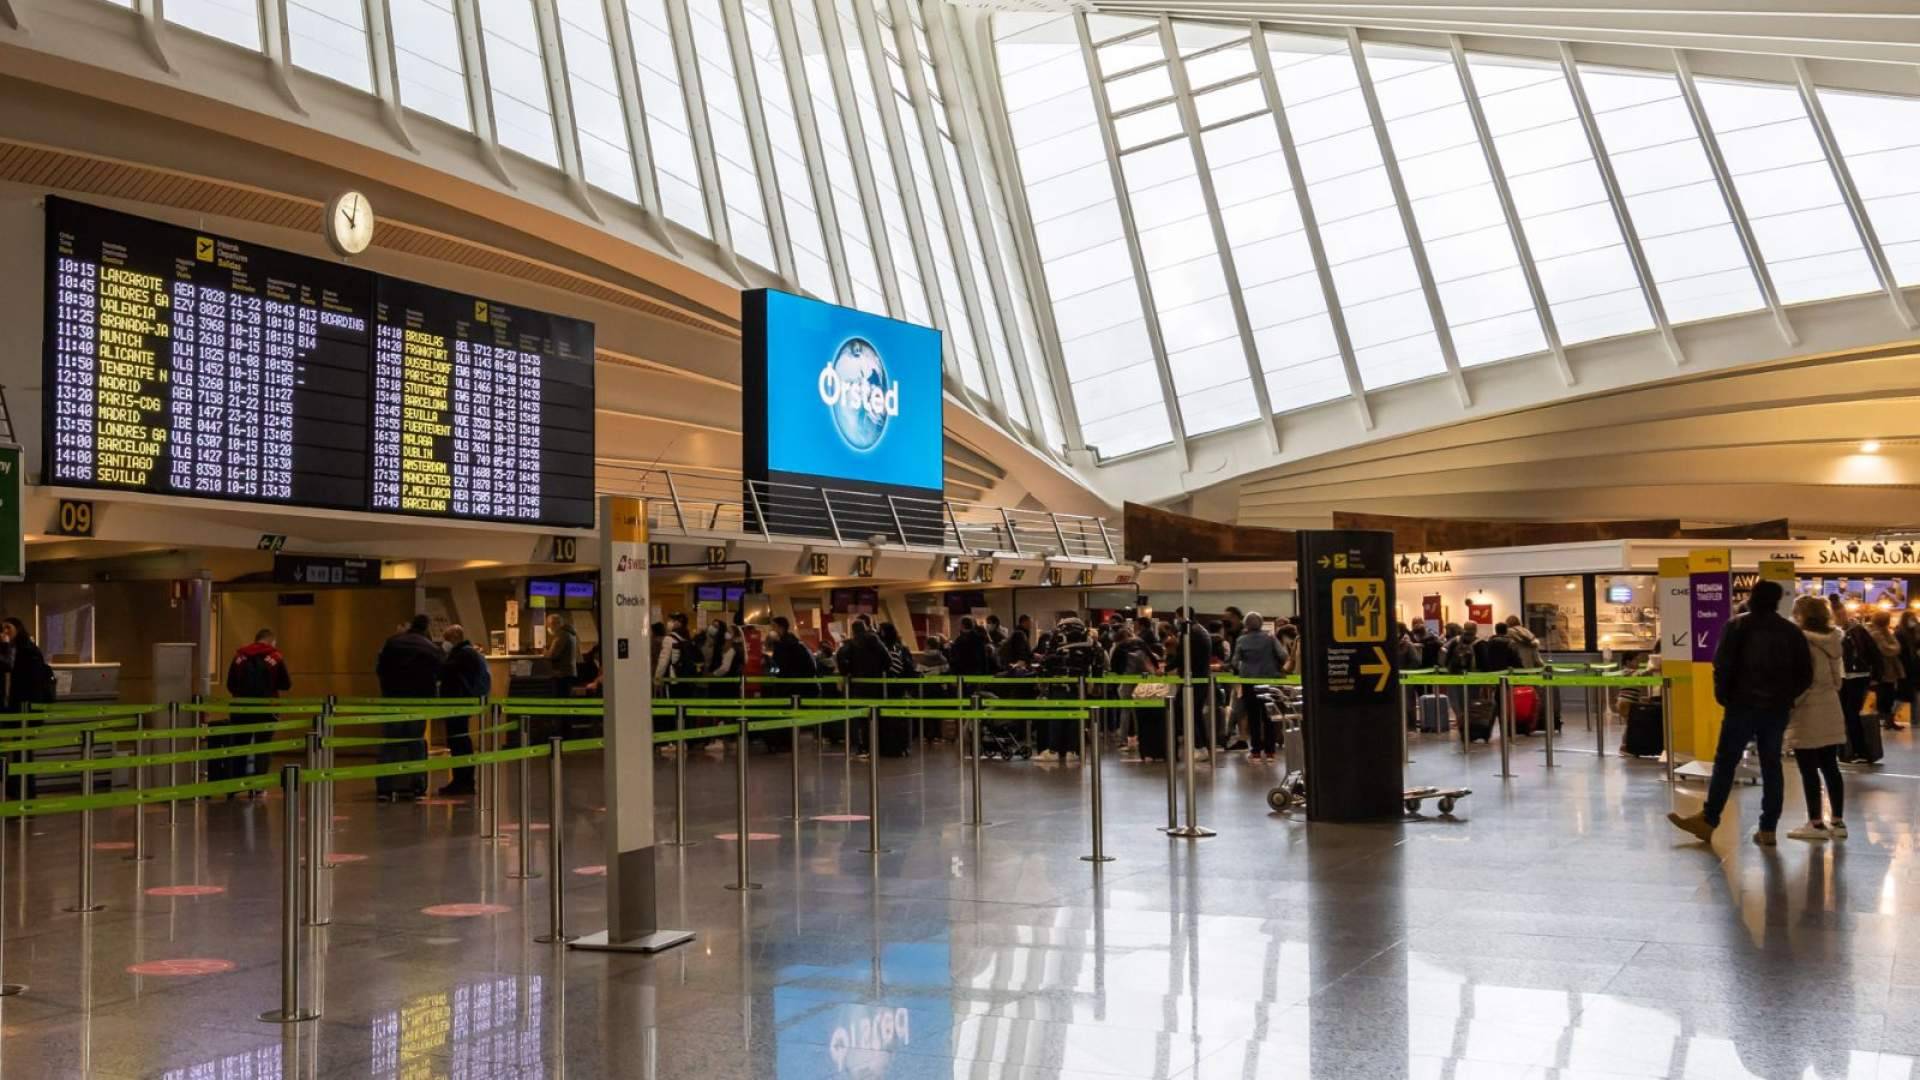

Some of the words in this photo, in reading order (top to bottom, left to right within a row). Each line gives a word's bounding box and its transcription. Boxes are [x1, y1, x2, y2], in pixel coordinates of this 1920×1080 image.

[58, 258, 96, 276] 10:15
[101, 266, 163, 292] LANZAROTE
[174, 282, 195, 298] AEA
[230, 294, 261, 312] 21-22
[265, 301, 295, 318] 09:43
[300, 307, 317, 322] A13
[320, 312, 365, 332] BOARDING
[58, 274, 95, 292] 10:45
[101, 282, 149, 303] LONDRES
[155, 294, 169, 307] GA
[174, 297, 195, 313] EZY
[230, 308, 261, 326] 19-20
[265, 315, 295, 331] 10:10
[299, 321, 317, 336] B16
[58, 290, 95, 308] 10:50
[101, 298, 156, 320] VALENCIA
[173, 312, 194, 328] VLG
[199, 316, 225, 333] 3968
[229, 322, 260, 340] 10-15
[265, 329, 294, 345] 10:15
[298, 335, 317, 350] B14
[58, 306, 95, 323] 11:25
[100, 313, 169, 337] GRANADA-JA
[173, 326, 194, 342] VLG
[229, 337, 260, 354] 10-15
[264, 343, 294, 359] 10:59
[377, 324, 402, 339] 14:10
[405, 330, 444, 347] BRUSELAS
[58, 321, 94, 339] 11:30
[100, 328, 142, 348] MUNICH
[173, 341, 194, 357] DLH
[198, 346, 224, 362] 1825
[264, 357, 294, 373] 10:55
[377, 337, 402, 352] 14:20
[405, 342, 448, 360] FRANKFURT
[57, 337, 94, 355] 11:40
[100, 344, 155, 365] ALICANTE
[172, 356, 194, 372] VLG
[198, 360, 224, 376] 1452
[229, 365, 259, 382] 10-15
[264, 371, 293, 387] 11:05
[377, 350, 402, 365] 14:55
[404, 356, 453, 374] DUSSELDORF
[57, 353, 94, 370] 11:50
[100, 360, 155, 380] TENERIFE
[160, 369, 168, 382] N
[172, 371, 193, 386] VLG
[228, 380, 259, 396] 10-15
[264, 385, 293, 401] 11:27
[376, 363, 402, 378] 15:10
[404, 368, 448, 386] PARIS-CDG
[57, 369, 93, 386] 12:30
[99, 375, 141, 393] MADRID
[172, 386, 193, 401] AEA
[228, 394, 259, 411] 21-22
[263, 400, 293, 415] 11:55
[376, 377, 401, 391] 15:10
[404, 382, 447, 398] STUTTGART
[818, 362, 899, 417] Ørsted
[57, 385, 93, 401] 13:20
[99, 390, 161, 411] PARIS-CDG
[172, 400, 193, 416] AFR
[197, 404, 223, 420] 1477
[228, 409, 259, 425] 23-24
[263, 414, 293, 429] 12:45
[376, 390, 401, 404] 15:40
[404, 394, 448, 411] BARCELONA
[376, 403, 401, 417] 15:45
[403, 407, 438, 421] SEVILLA
[56, 401, 93, 417] 13:40
[99, 406, 141, 423] MADRID
[171, 415, 193, 430] IBE
[228, 423, 258, 439] 16-18
[263, 428, 292, 443] 13:05
[375, 416, 401, 430] 15:55
[403, 420, 451, 436] FUERTEVENT
[56, 416, 92, 433] 13:55
[98, 421, 147, 439] LONDRES
[151, 428, 167, 442] GA
[171, 430, 192, 445] VLG
[227, 437, 258, 453] 10-15
[263, 442, 292, 457] 13:20
[375, 429, 401, 443] 16:30
[403, 433, 433, 447] MALAGA
[56, 432, 92, 448] 14:00
[98, 437, 160, 456] BARCELONA
[171, 445, 192, 460] VLG
[196, 448, 222, 463] 1427
[227, 452, 258, 467] 10-15
[262, 456, 292, 471] 13:30
[375, 442, 401, 456] 16:55
[403, 445, 433, 460] DUBLIN
[56, 448, 92, 464] 14:00
[98, 453, 153, 470] SANTIAGO
[170, 460, 192, 474] IBE
[227, 466, 257, 481] 16-18
[262, 470, 291, 485] 13:35
[375, 456, 400, 469] 17:15
[403, 458, 447, 474] AMSTERDAM
[56, 464, 92, 480] 14:05
[98, 468, 146, 485] SEVILLA
[170, 474, 192, 489] VLG
[226, 480, 257, 496] 10-15
[262, 484, 291, 498] 13:30
[374, 469, 400, 482] 17:35
[402, 471, 451, 486] MANCHESTER
[374, 482, 400, 495] 17:40
[402, 484, 451, 499] P.MALLORCA
[374, 495, 400, 508] 17:45
[402, 497, 446, 511] BARCELONA
[61, 503, 90, 532] 09
[556, 539, 575, 560] 10
[652, 544, 670, 564] 11
[710, 548, 725, 562] 12
[813, 555, 826, 573] 13
[860, 558, 871, 574] 14
[1394, 560, 1451, 574] TAGLORIA
